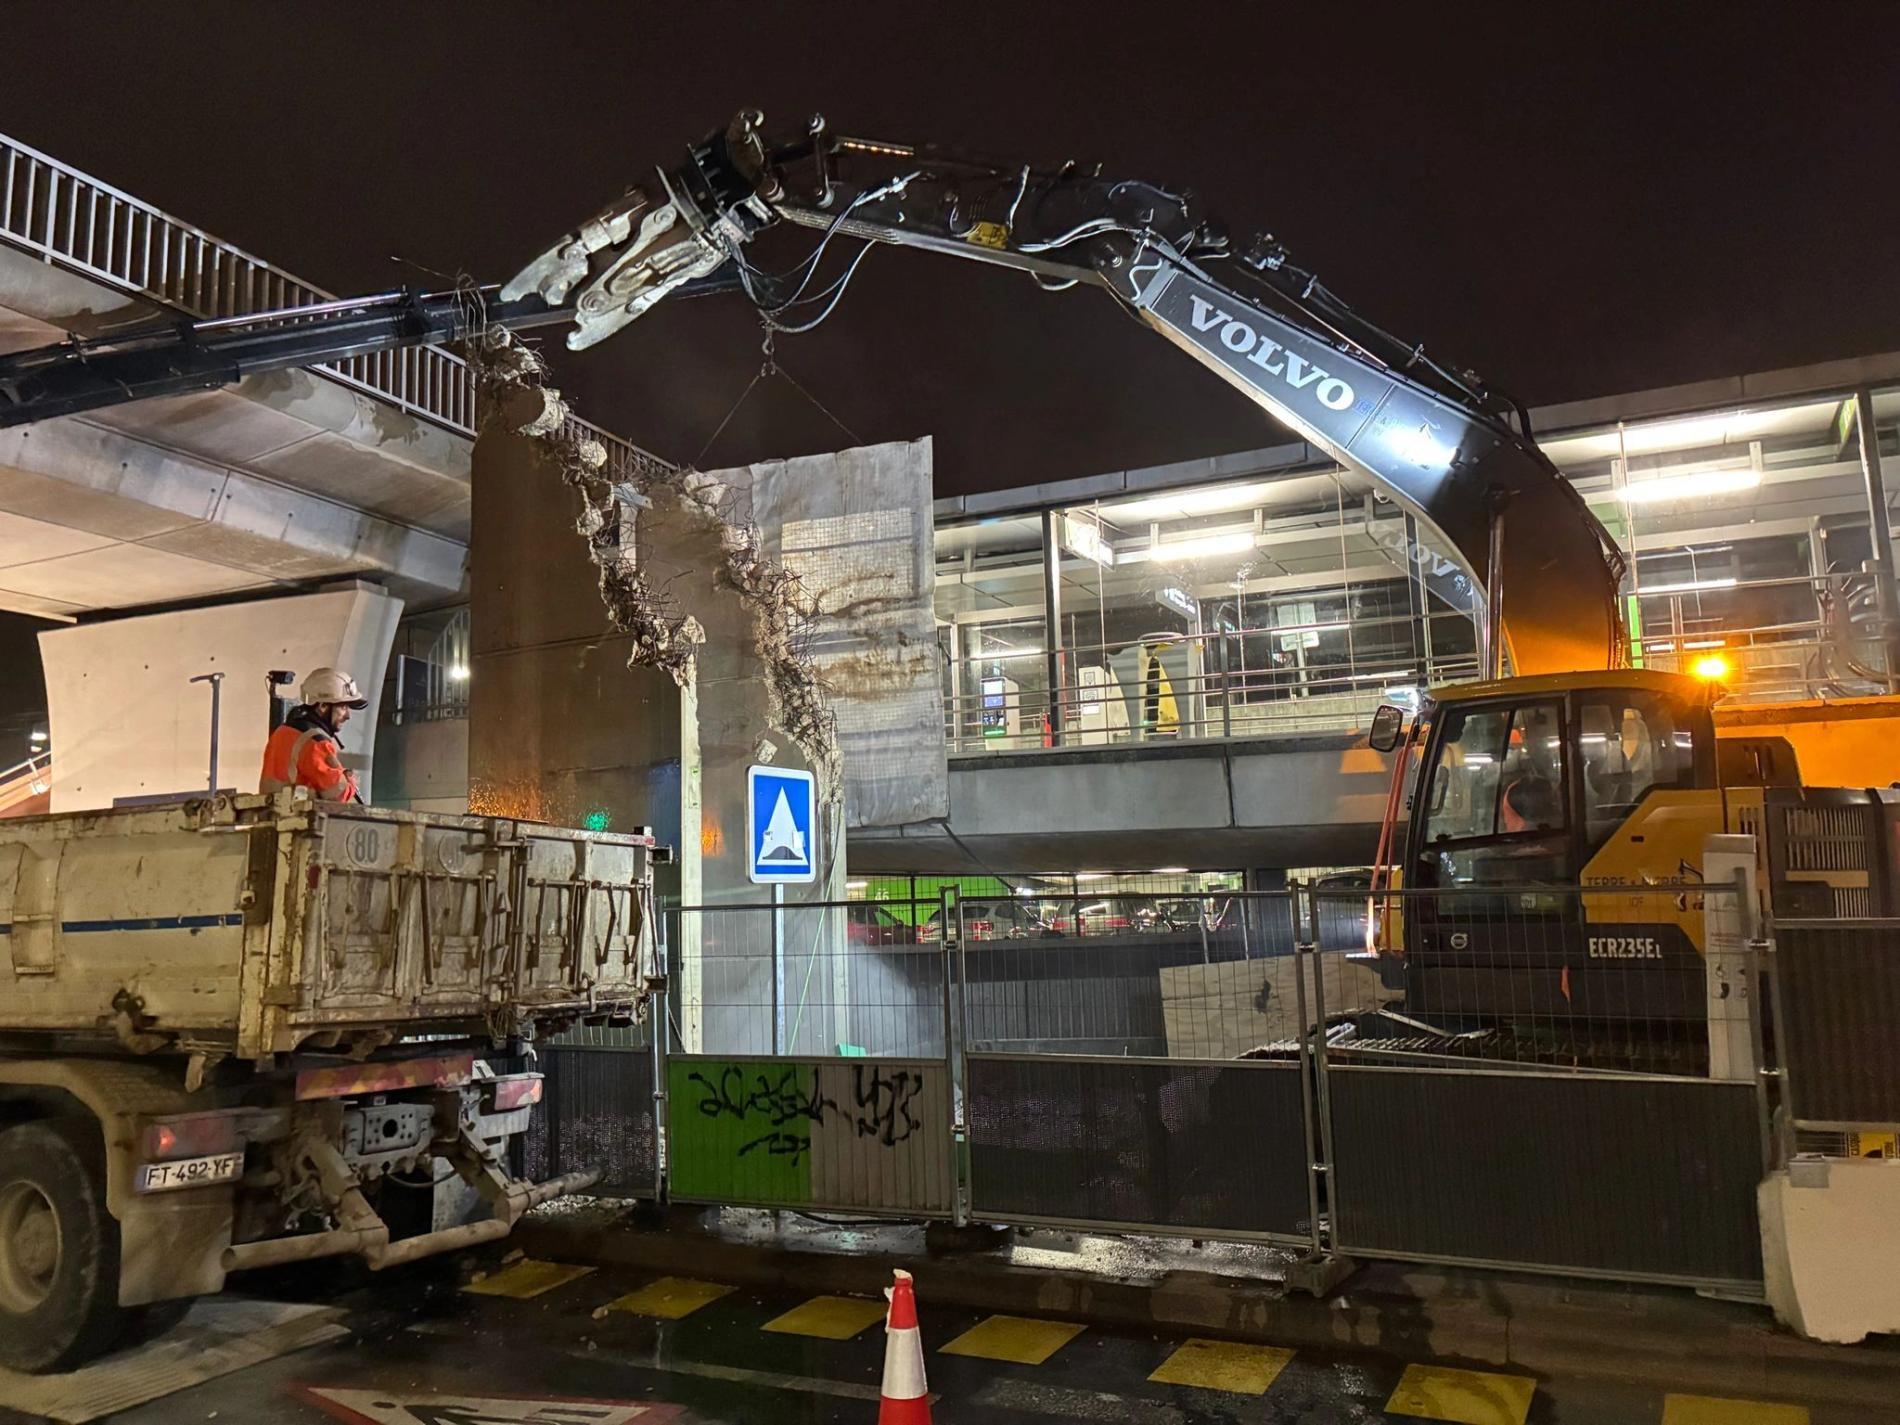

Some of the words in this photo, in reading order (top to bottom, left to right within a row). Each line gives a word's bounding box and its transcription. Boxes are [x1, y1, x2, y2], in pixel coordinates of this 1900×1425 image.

[1190, 294, 1354, 411] VOLVO
[354, 828, 379, 864] 80
[147, 1157, 233, 1186] FT-492-YF
